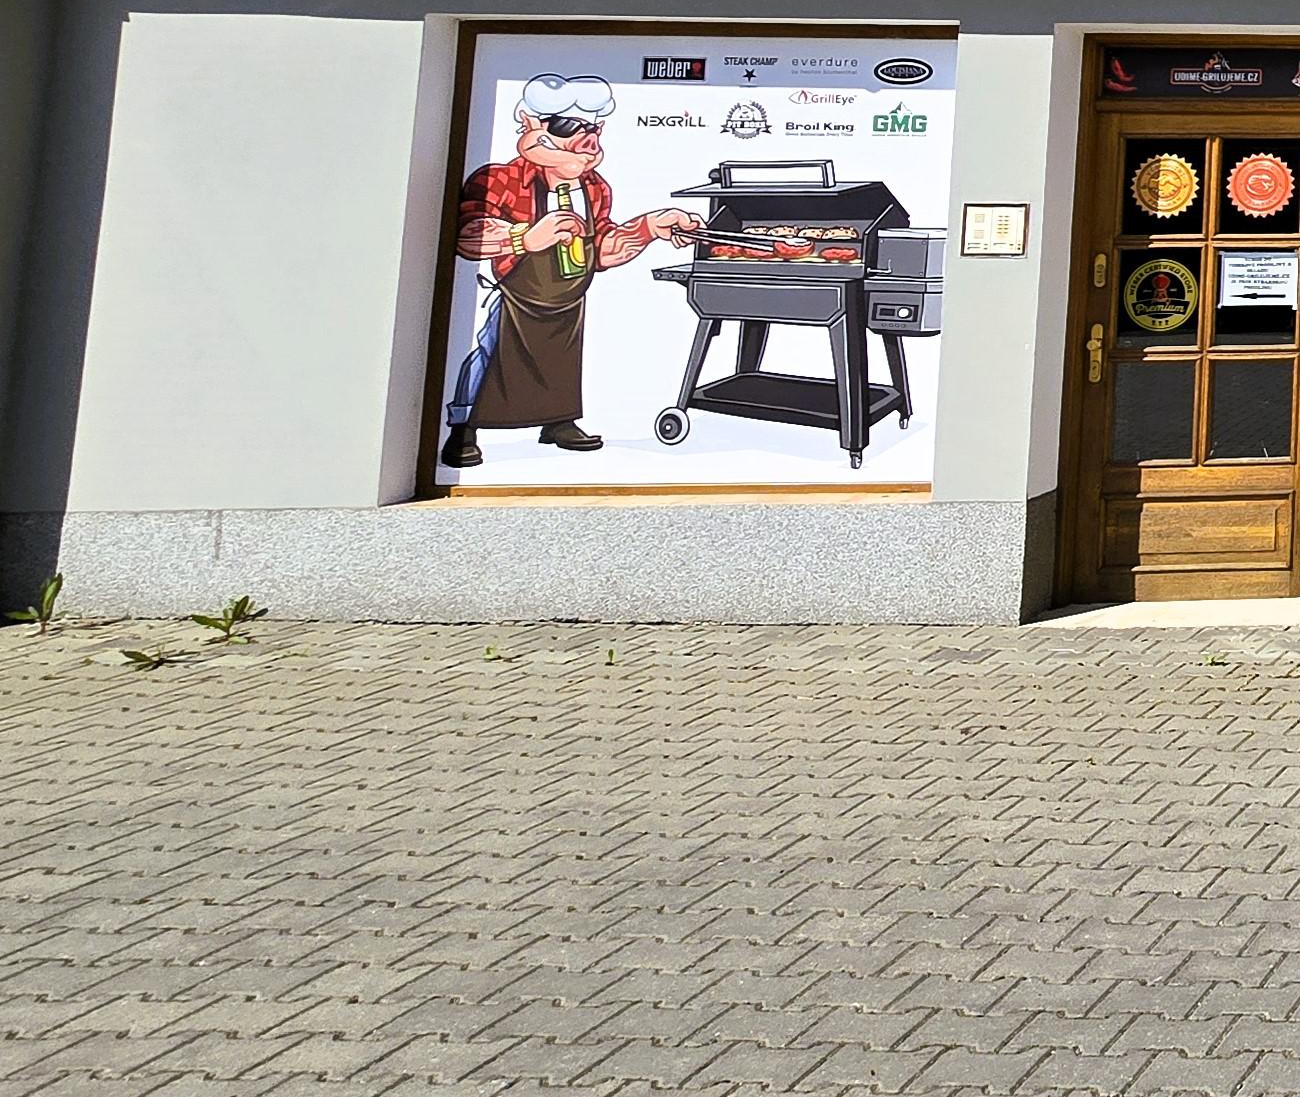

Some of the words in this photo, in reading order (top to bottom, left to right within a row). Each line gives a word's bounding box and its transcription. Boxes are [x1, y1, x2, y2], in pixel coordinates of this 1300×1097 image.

[724, 56, 749, 66] STEAK
[750, 57, 778, 66] CHAMP
[791, 57, 858, 68] everdure
[647, 57, 691, 78] weber
[811, 94, 855, 106] GrillEye
[785, 121, 820, 131] Broil
[823, 122, 855, 132] King
[872, 114, 928, 133] GMG
